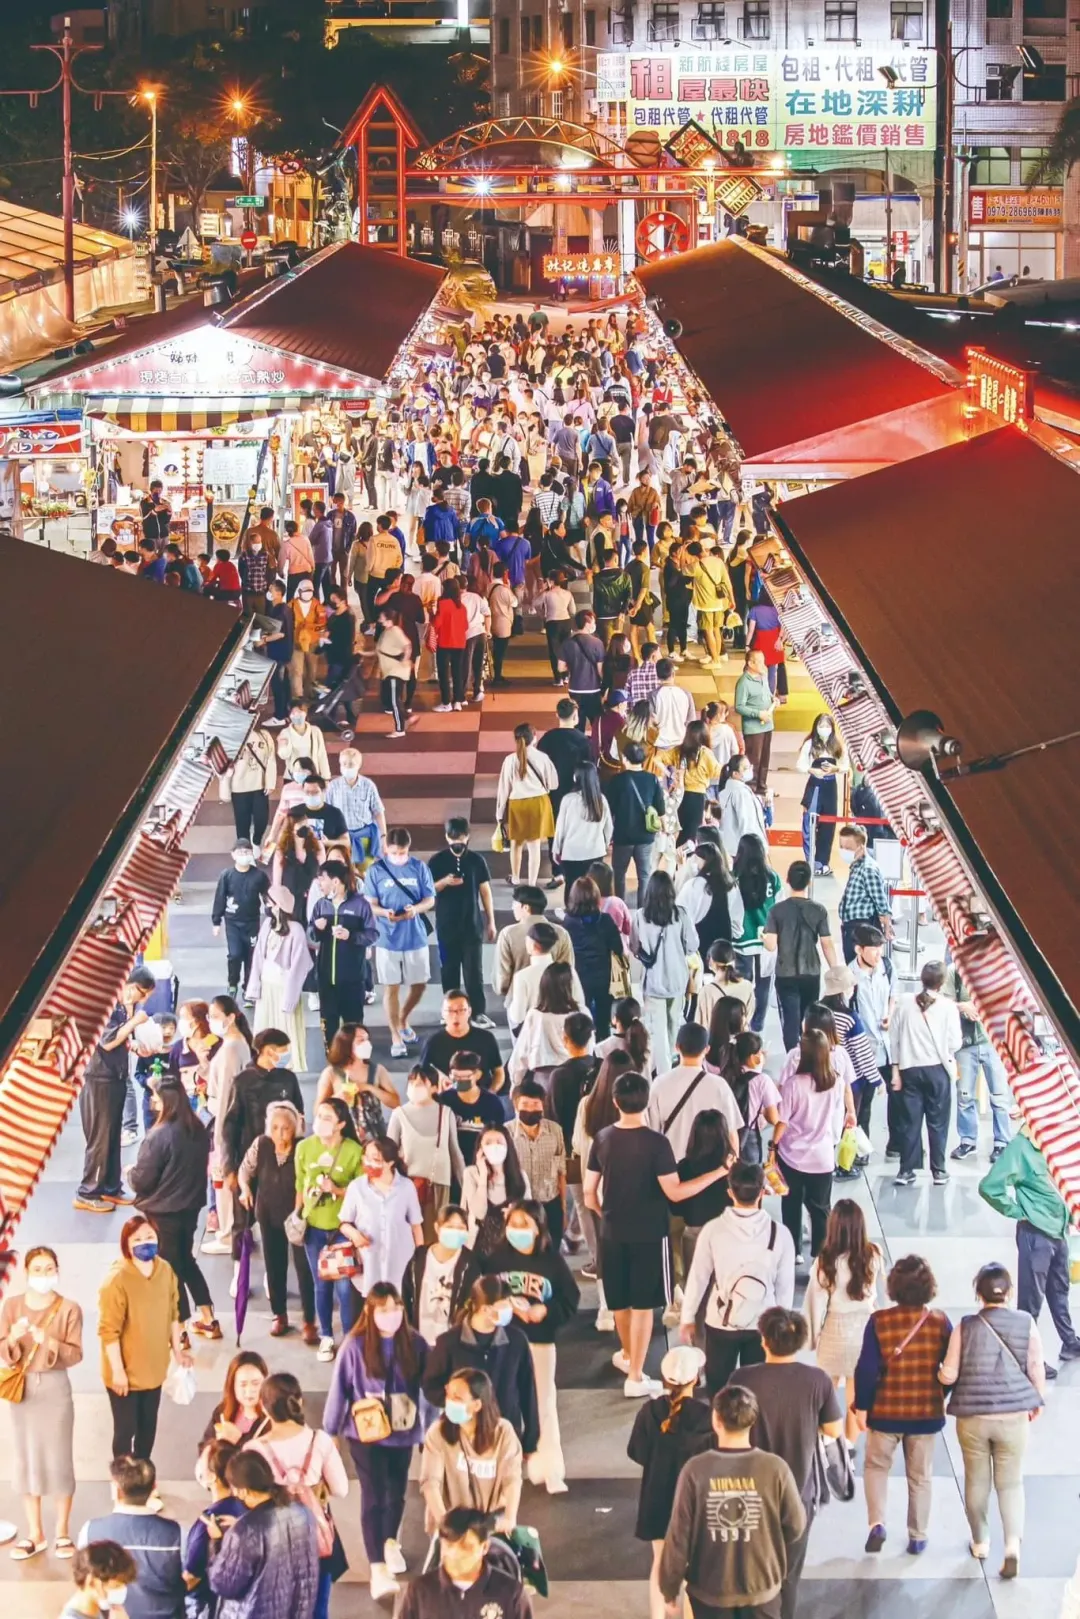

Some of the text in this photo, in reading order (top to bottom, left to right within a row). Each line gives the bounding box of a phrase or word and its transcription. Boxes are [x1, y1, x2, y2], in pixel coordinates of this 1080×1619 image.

[631, 58, 672, 100] 租
[678, 78, 769, 101] 屋最快
[785, 89, 922, 116] 在地深耕
[711, 106, 768, 125] 代租代管
[784, 124, 925, 146] 房地鑑價銷售
[709, 1478, 755, 1491] NIRVANA
